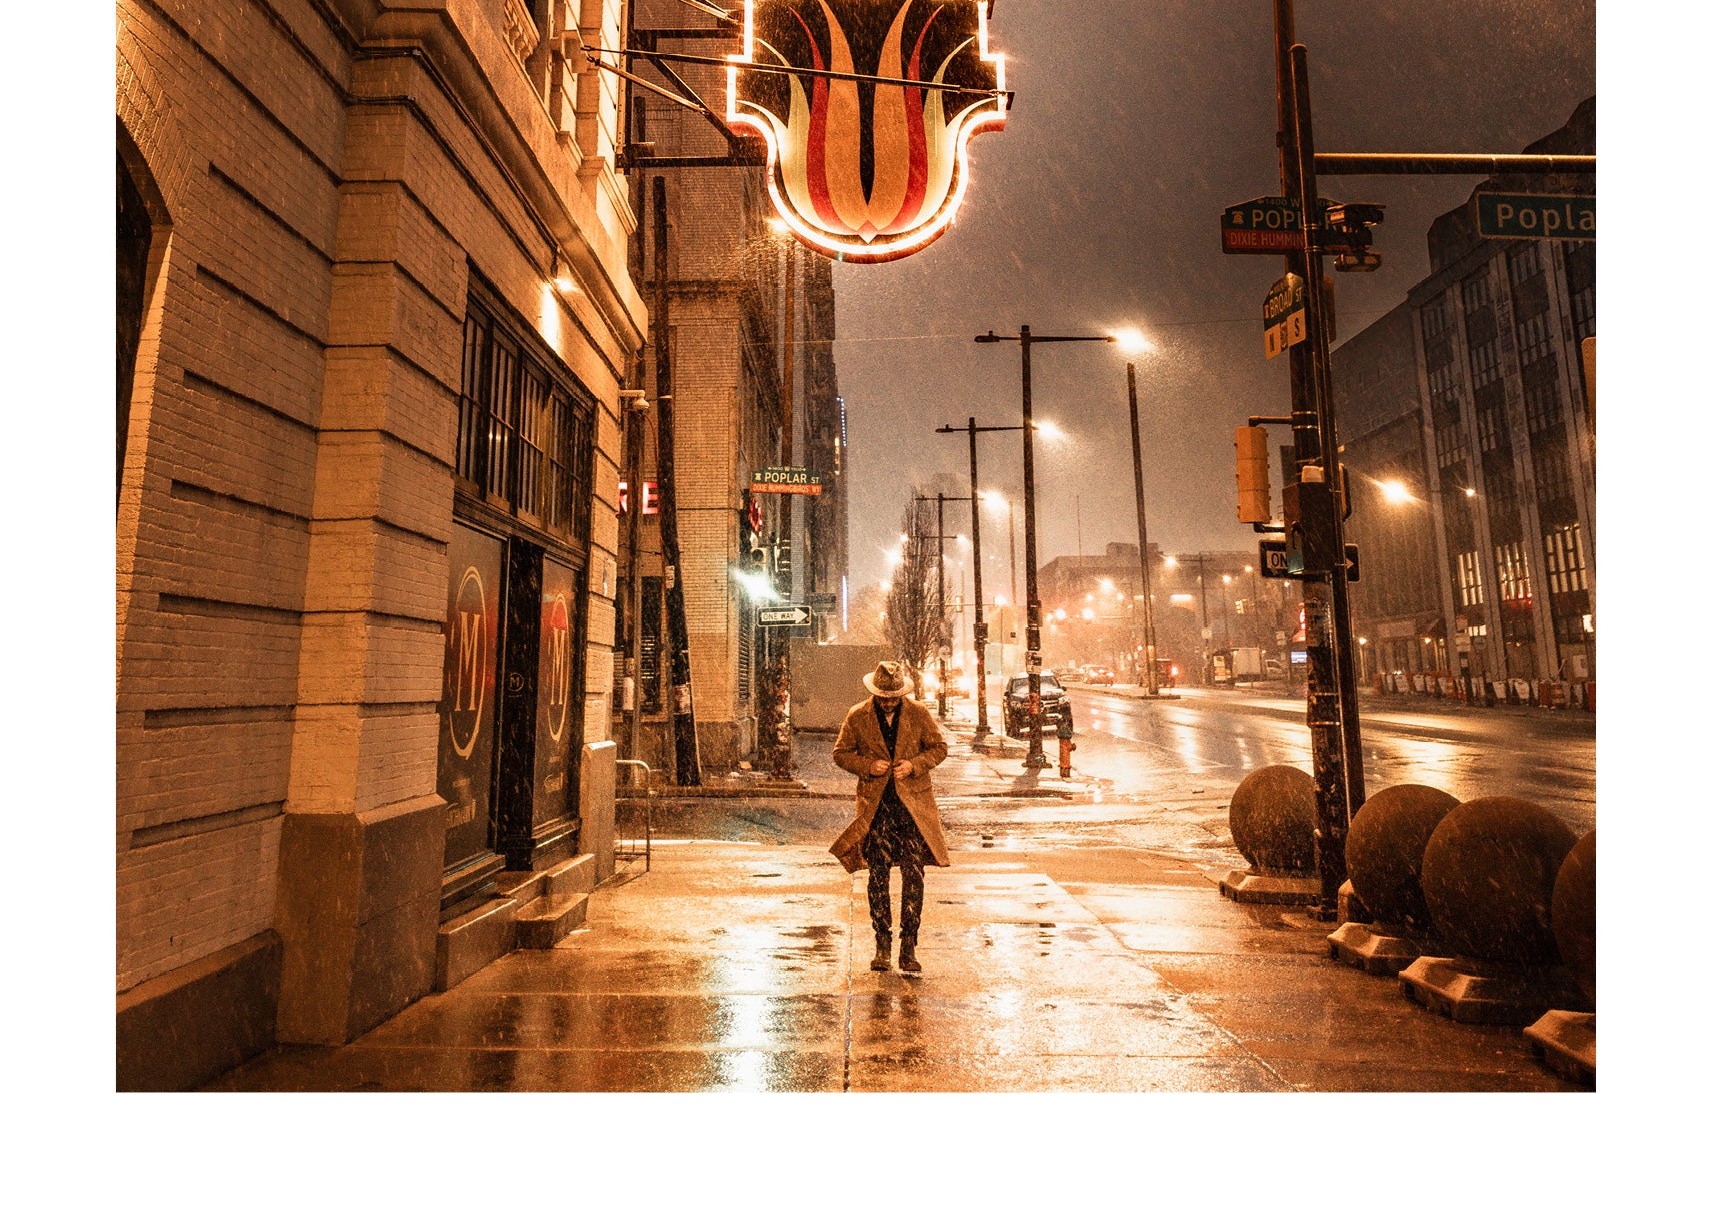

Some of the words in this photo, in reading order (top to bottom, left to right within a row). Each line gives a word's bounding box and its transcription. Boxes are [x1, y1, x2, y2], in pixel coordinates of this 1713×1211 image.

[1230, 232, 1257, 246] DIXIE
[1261, 233, 1305, 248] HUMMIN
[1269, 287, 1293, 318] BROAD
[764, 472, 807, 483] POPLAR
[811, 476, 820, 484] ST
[1271, 553, 1288, 568] ON
[763, 613, 779, 621] ONE
[780, 612, 795, 620] WAY
[455, 611, 480, 711] M
[550, 627, 565, 705] M
